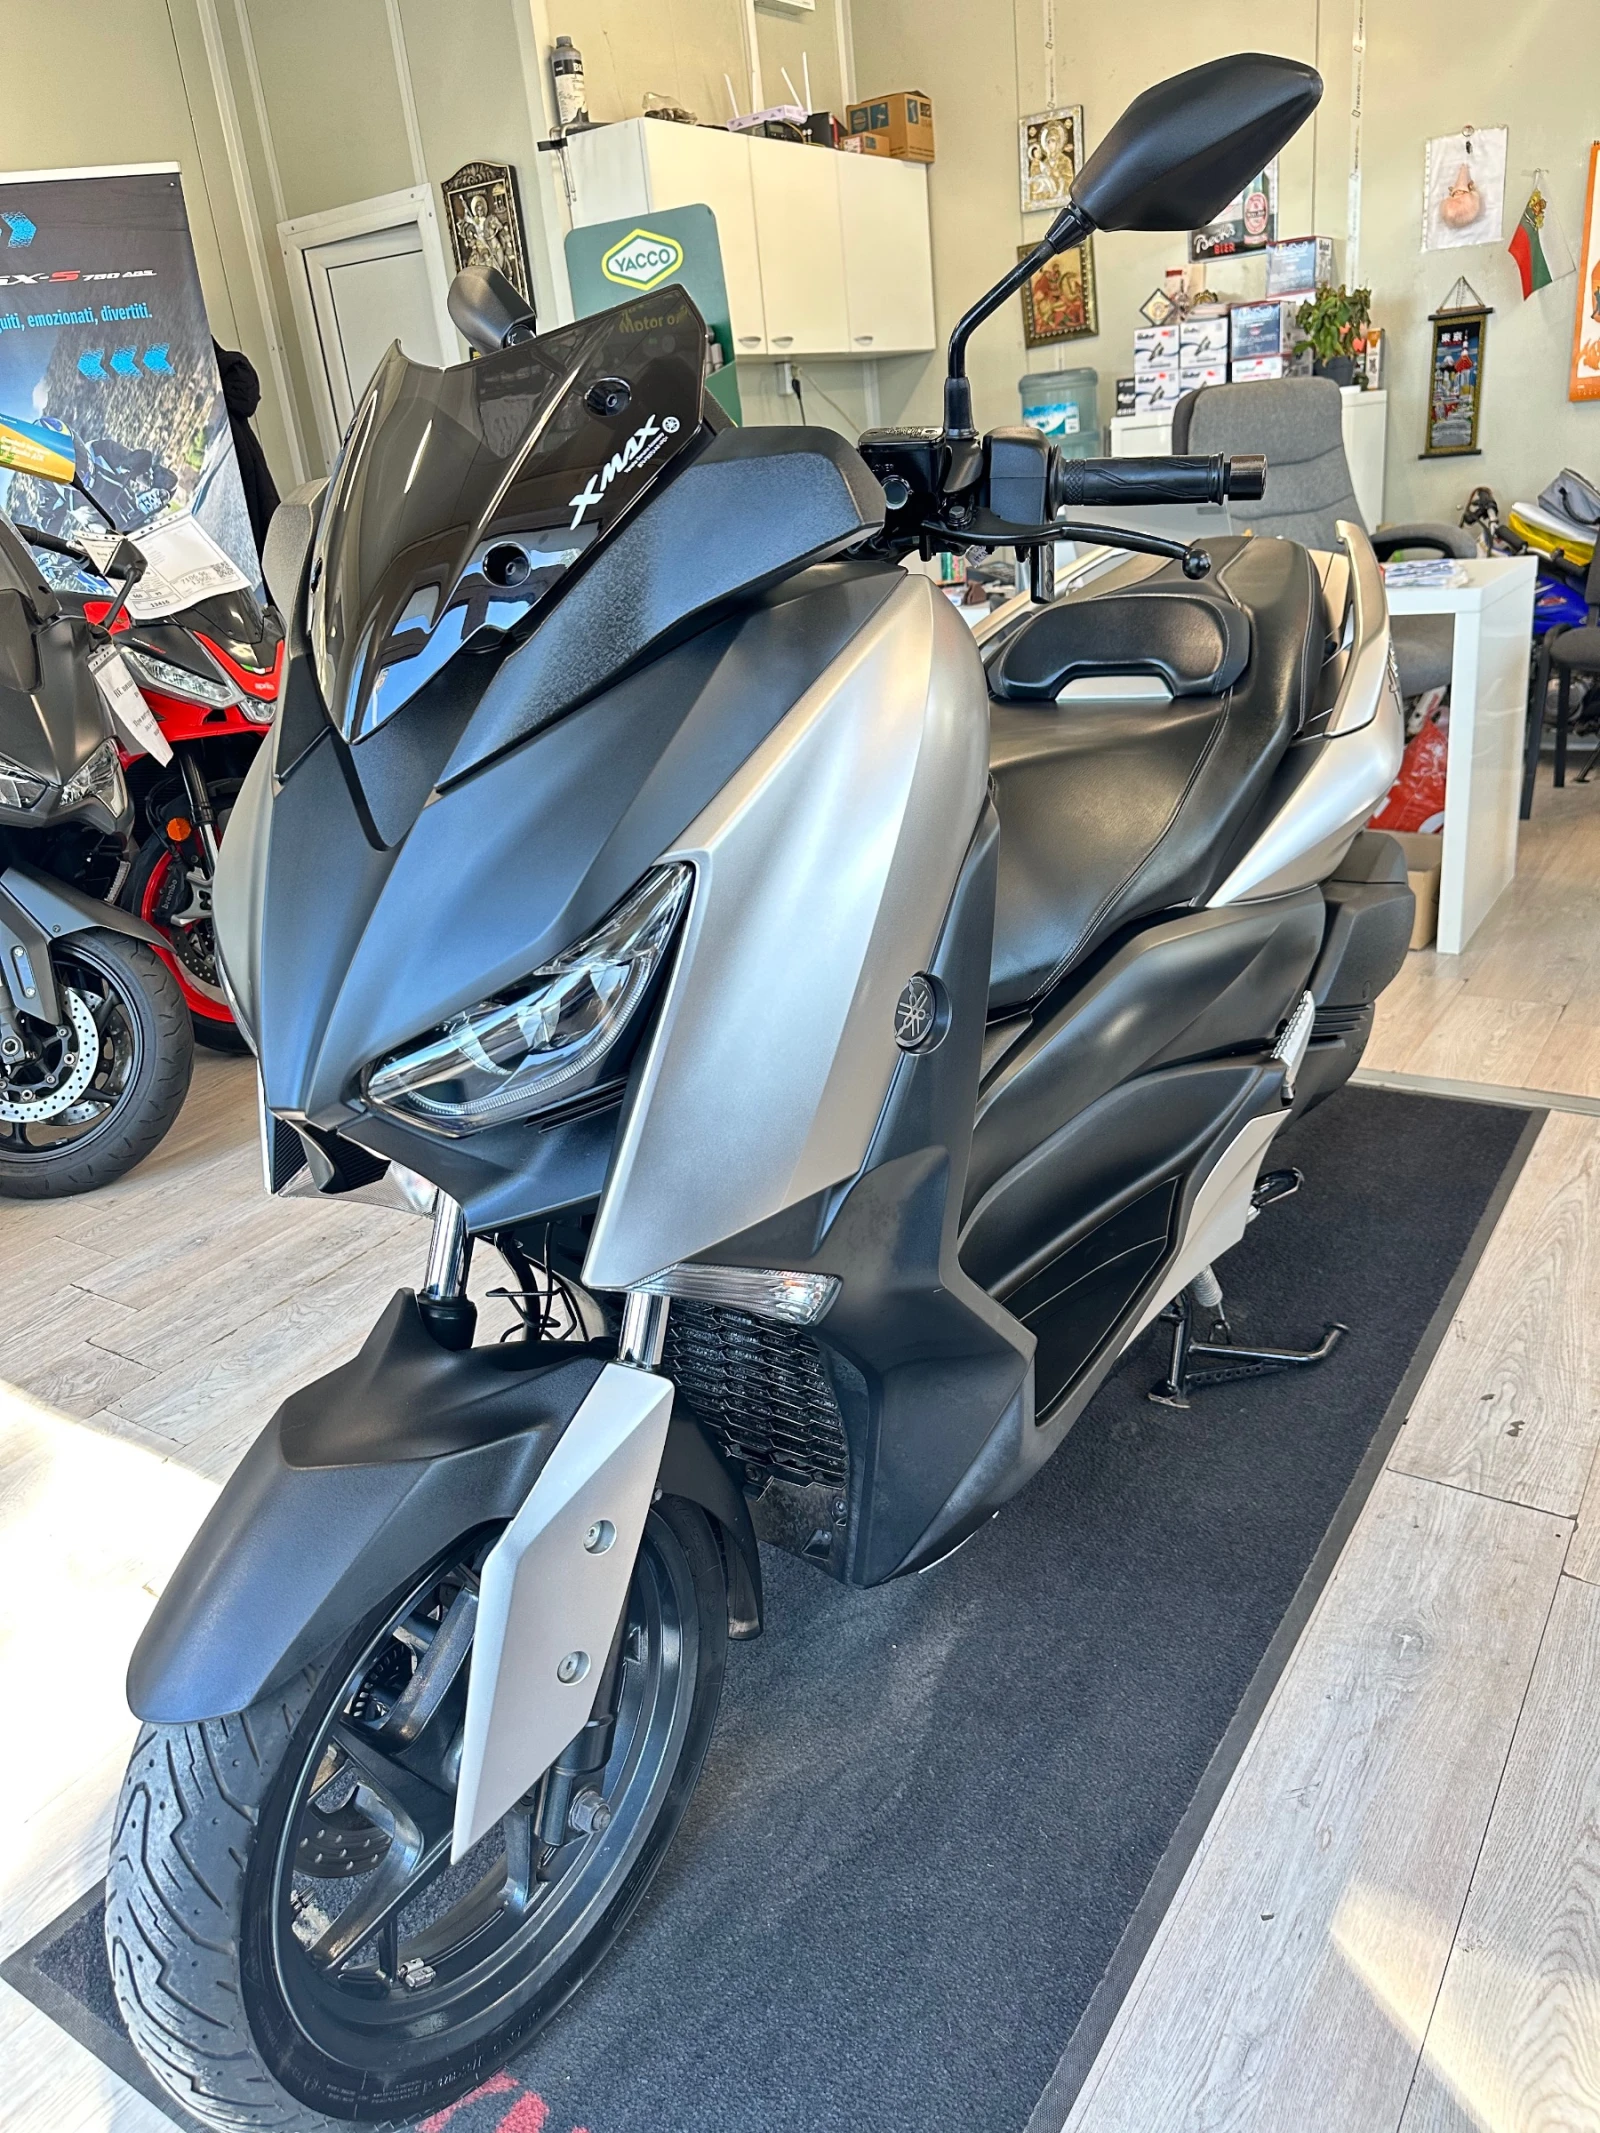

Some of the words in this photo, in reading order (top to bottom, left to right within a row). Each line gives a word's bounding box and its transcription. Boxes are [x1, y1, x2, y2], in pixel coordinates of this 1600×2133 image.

[1213, 242, 1236, 254] BIER
[615, 249, 671, 272] YACCO
[27, 307, 99, 328] emozionati,
[101, 302, 153, 322] divertiti.
[619, 315, 664, 334] Motor
[568, 414, 660, 530] XMAX
[161, 879, 178, 910] brembo
